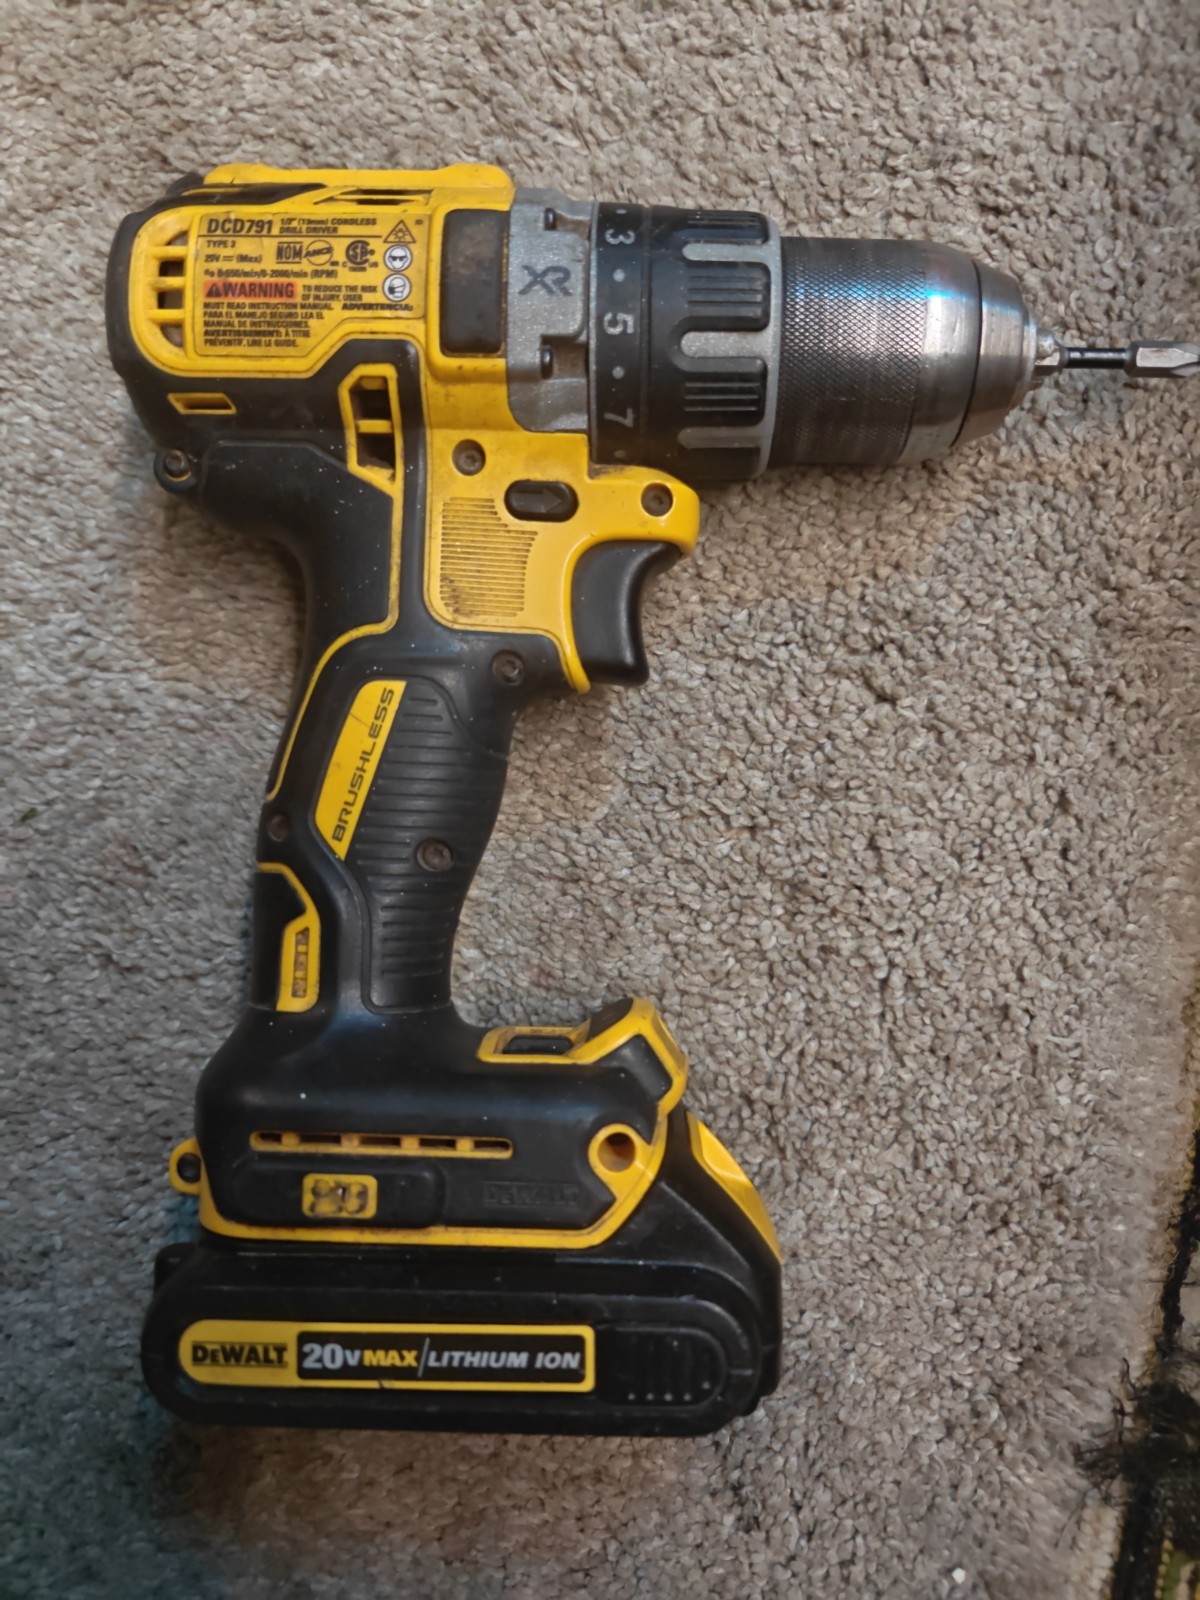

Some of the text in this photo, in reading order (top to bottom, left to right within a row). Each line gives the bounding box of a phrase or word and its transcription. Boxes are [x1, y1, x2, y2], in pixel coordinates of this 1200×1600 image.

[207, 218, 273, 234] DCD791
[604, 228, 636, 245] 3
[206, 240, 229, 248] TYPE
[237, 254, 262, 263] (Max)
[276, 242, 303, 263] NOM
[311, 269, 338, 279] (RPM)
[518, 265, 573, 297] XR
[223, 282, 294, 299] WARNING
[302, 285, 378, 294] TO REDUCE THE RISK
[343, 294, 363, 302] USER
[203, 302, 225, 310] MUST
[226, 302, 246, 310] READ
[248, 302, 298, 310] INSTRUCTION
[236, 311, 268, 319] MANEJO
[269, 311, 299, 319] SEGURO
[301, 311, 315, 319] LEA
[316, 311, 325, 320] EL
[603, 312, 635, 336] 5
[292, 329, 311, 338] TITRE
[247, 338, 262, 347] LIRE
[264, 338, 272, 347] LE
[603, 407, 635, 429] 7
[331, 687, 395, 843] BRUSHLESS
[362, 1349, 418, 1367] MAX
[427, 1350, 529, 1369] LITHIUM
[535, 1351, 581, 1370] ION
